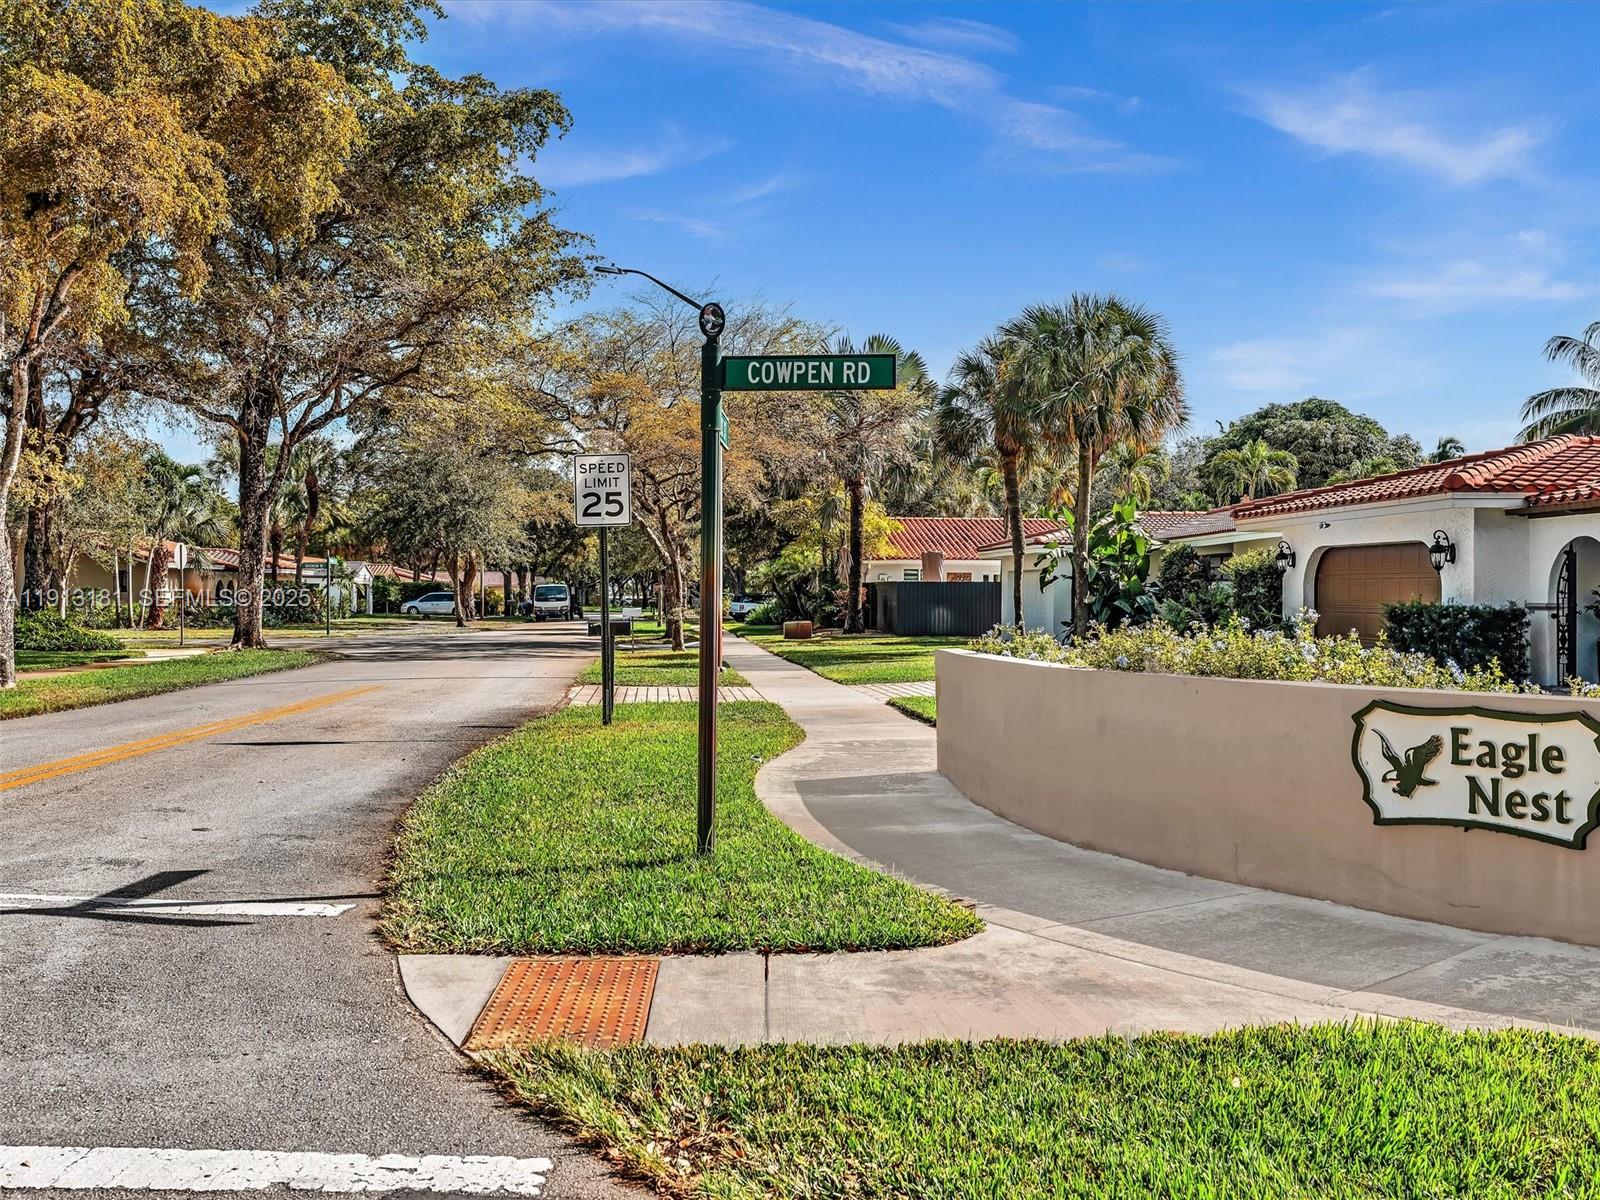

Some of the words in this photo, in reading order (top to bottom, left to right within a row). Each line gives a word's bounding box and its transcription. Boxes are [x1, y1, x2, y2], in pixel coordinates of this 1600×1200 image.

[747, 361, 834, 384] COWPEN
[843, 361, 871, 384] RD
[579, 463, 625, 474] SPEED
[584, 477, 620, 488] LIMIT
[582, 491, 624, 517] 25
[1450, 727, 1566, 778] Eagle
[1465, 775, 1573, 825] Nest
